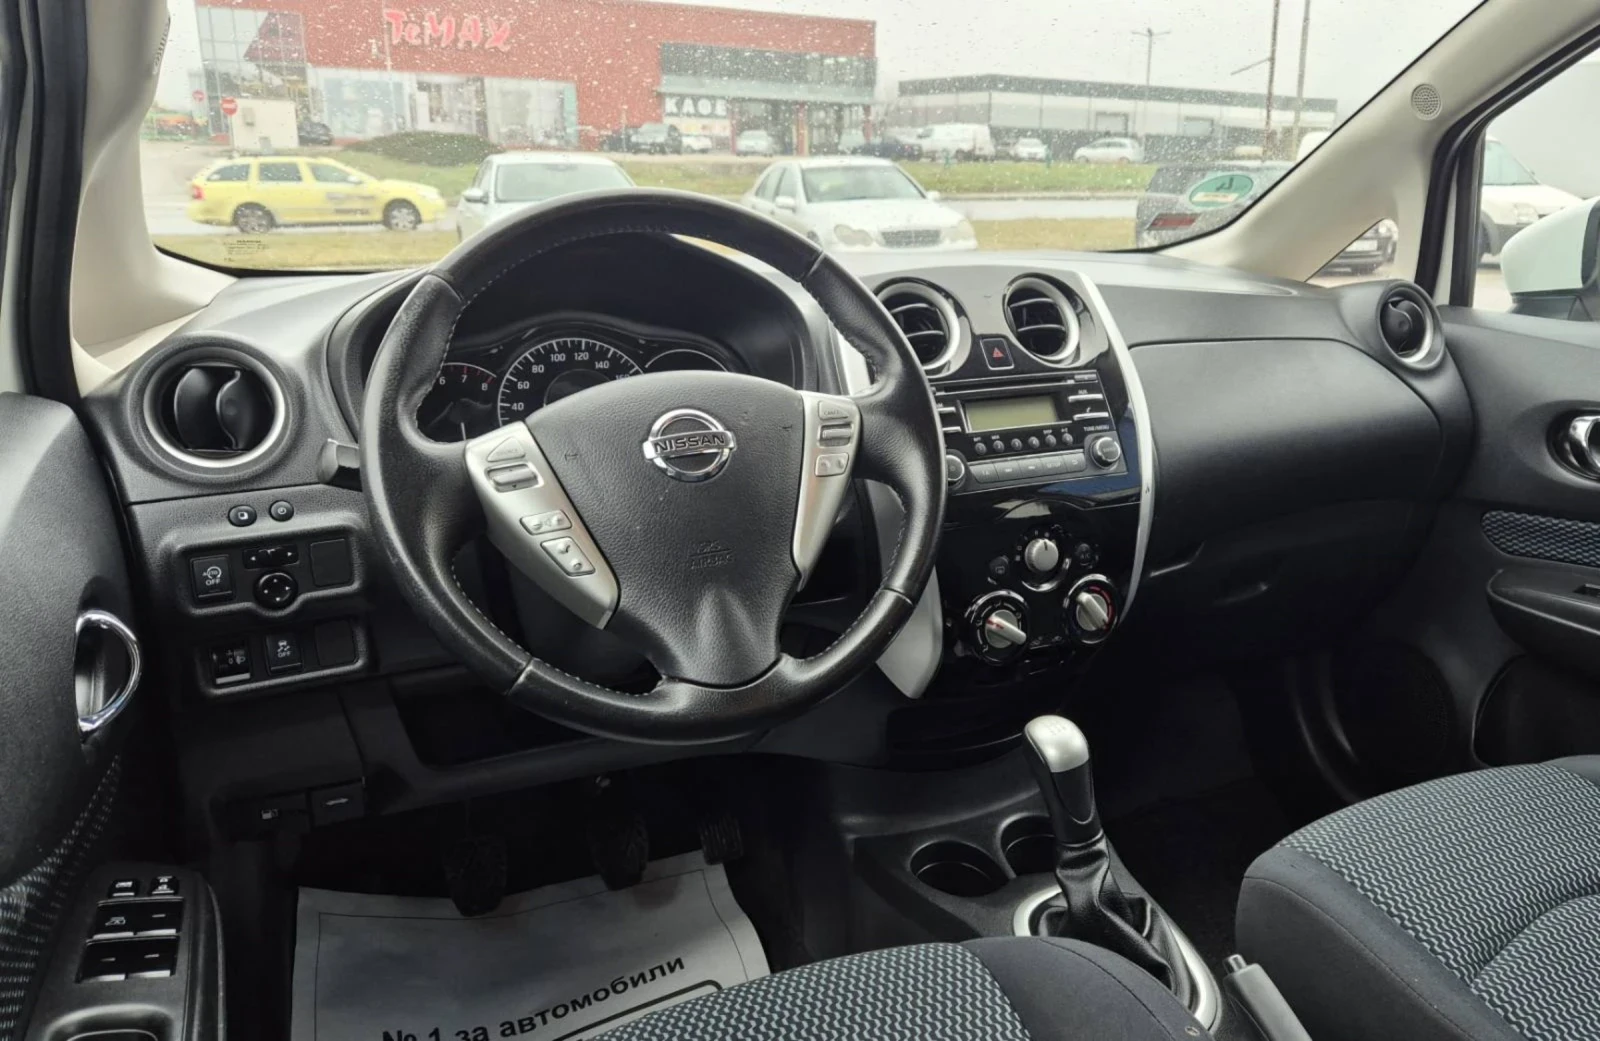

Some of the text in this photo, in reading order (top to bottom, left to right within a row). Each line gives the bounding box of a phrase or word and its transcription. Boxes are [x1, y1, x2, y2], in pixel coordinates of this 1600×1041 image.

[550, 353, 566, 362] 100
[574, 352, 589, 361] 120
[532, 364, 544, 374] 80
[595, 360, 610, 369] 140
[439, 377, 446, 385] 6
[461, 374, 467, 383] 7
[481, 382, 488, 391] 8
[517, 380, 530, 390] 60
[511, 402, 524, 411] 40
[655, 433, 725, 453] NISSAN
[277, 651, 291, 659] OFF
[499, 956, 685, 1038] автомобили
